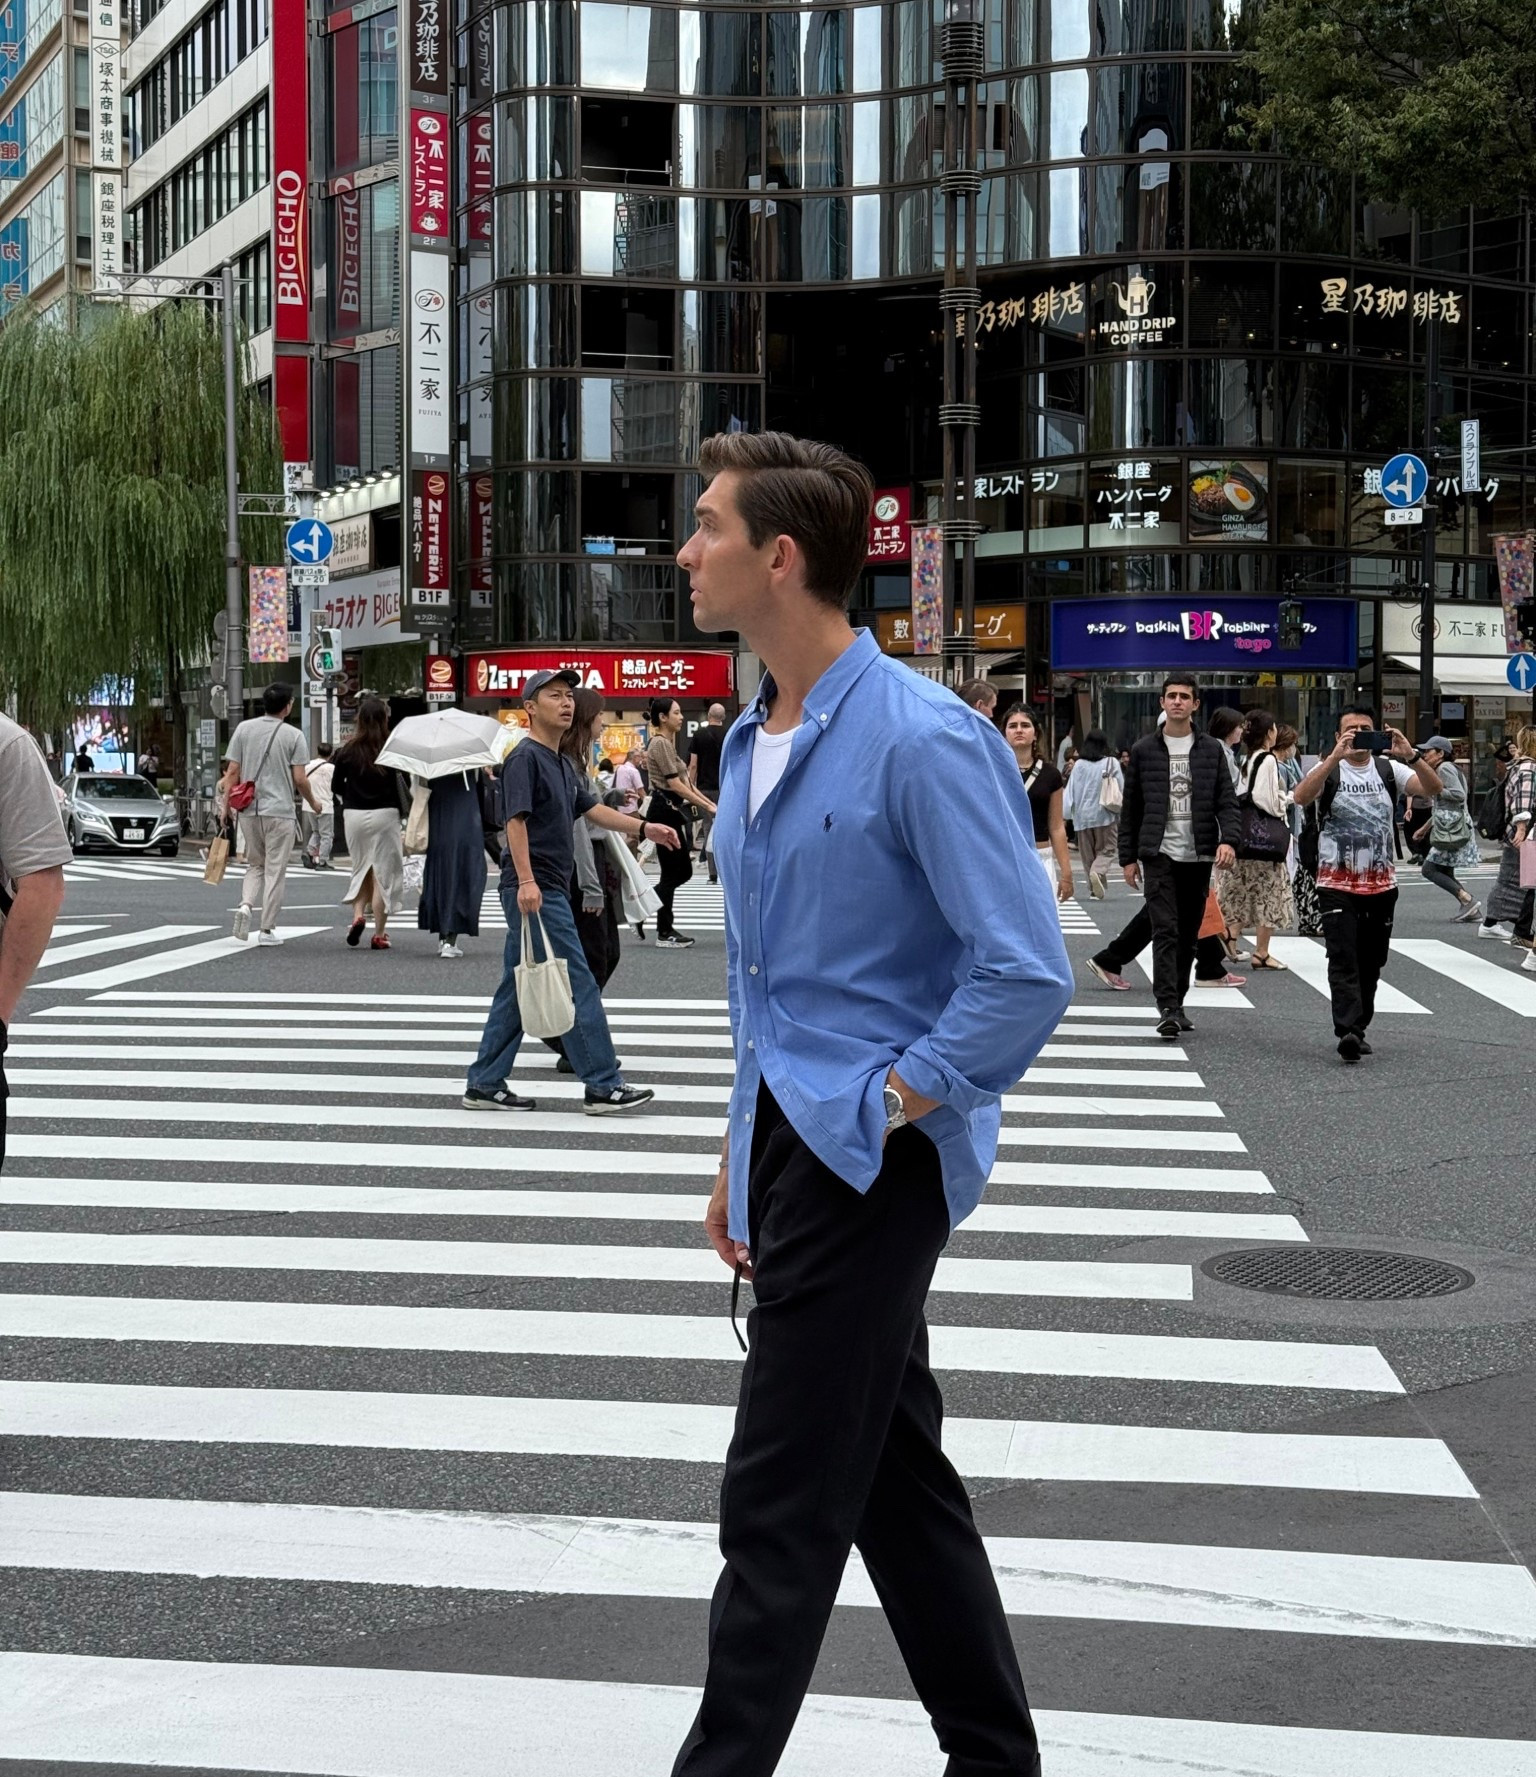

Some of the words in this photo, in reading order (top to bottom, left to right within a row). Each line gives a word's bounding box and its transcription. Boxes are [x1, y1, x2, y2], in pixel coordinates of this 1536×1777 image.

[415, 0, 440, 83] 乃珈琲店
[422, 94, 435, 104] 3F
[99, 61, 115, 163] 塚本商事機械
[414, 136, 427, 206] レストラン
[428, 139, 445, 210] 不二家
[277, 170, 302, 247] ECHO
[100, 182, 116, 290] 銀座税理士法
[422, 237, 436, 246] 2F
[278, 252, 304, 306] BIG
[1320, 277, 1463, 326] 星乃珈琲店
[1099, 318, 1139, 334] HAND
[1142, 317, 1176, 329] DRIP
[1110, 331, 1163, 345] COFFEE
[418, 322, 441, 401] 不二家
[418, 409, 442, 417] FUJIYA
[424, 455, 436, 464] 1F
[1465, 423, 1476, 488] スクランブル式
[1117, 462, 1151, 480] 銀座
[1097, 485, 1172, 503] ハンバーグ
[1108, 510, 1159, 530] 不二家
[1221, 514, 1244, 522] GINZA
[413, 496, 423, 562] 絶品バーガー
[874, 526, 900, 540] 不二家
[428, 498, 442, 585] ZETTERIA
[868, 541, 905, 556] レストラン
[418, 591, 442, 602] B1F
[325, 594, 367, 629] カラオケ
[374, 594, 392, 624] BIG
[1087, 622, 1126, 634] サーティワン
[1135, 621, 1180, 634] baskin
[1224, 622, 1269, 634] robbins
[1449, 621, 1486, 637] 不二家
[1491, 624, 1507, 637] FU
[621, 659, 695, 675] 絶品バーガー
[488, 664, 605, 690] ZETTIA
[621, 678, 659, 689] フェアトレード
[659, 676, 695, 690] コーヒー
[429, 692, 444, 700] B1F
[1170, 782, 1188, 792] Lee
[1338, 780, 1385, 794] Brookly
